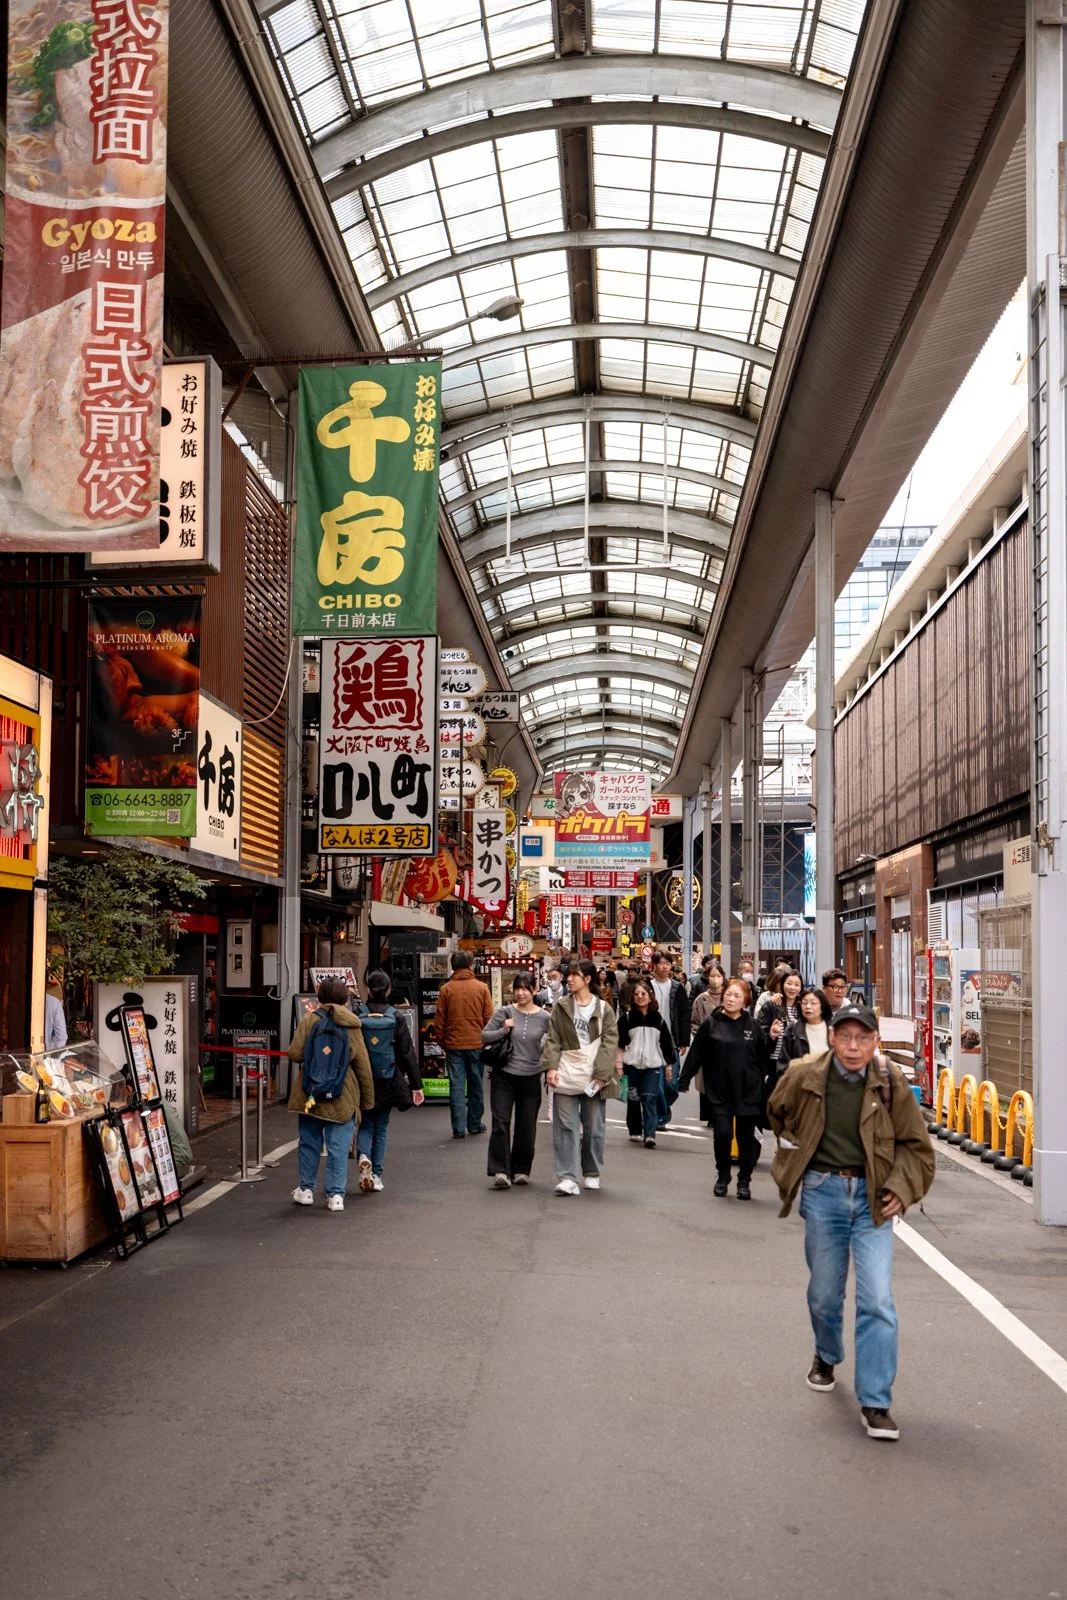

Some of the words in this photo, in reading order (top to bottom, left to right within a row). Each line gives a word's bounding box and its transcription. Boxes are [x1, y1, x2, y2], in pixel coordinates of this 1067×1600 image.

[41, 217, 157, 251] Gyoza
[60, 249, 111, 273] 일본식
[117, 251, 155, 271] 만두
[81, 279, 153, 517] 日式煎饺
[180, 373, 198, 459] お好み焼
[412, 375, 437, 472] お好み焼
[316, 380, 411, 587] 千房
[179, 480, 197, 548] 鉄板焼
[318, 593, 402, 609] CHIBO
[321, 613, 397, 628] 千日前本店
[95, 633, 151, 644] PLATINUM
[155, 632, 196, 643] AROMA
[341, 644, 417, 725] 鶏
[171, 729, 183, 738] 3F
[326, 734, 430, 756] 大阪下町焼鳥
[600, 775, 646, 784] キャバクラ
[104, 793, 191, 806] 06-6643-8887
[652, 799, 671, 815] 通
[208, 815, 225, 831] CHIBO
[558, 810, 647, 834] ポケパラ
[324, 828, 425, 849] なんば2号店
[476, 818, 504, 895] 串かつ
[164, 991, 177, 1055] お好み焼
[221, 1028, 253, 1036] PLATINUM
